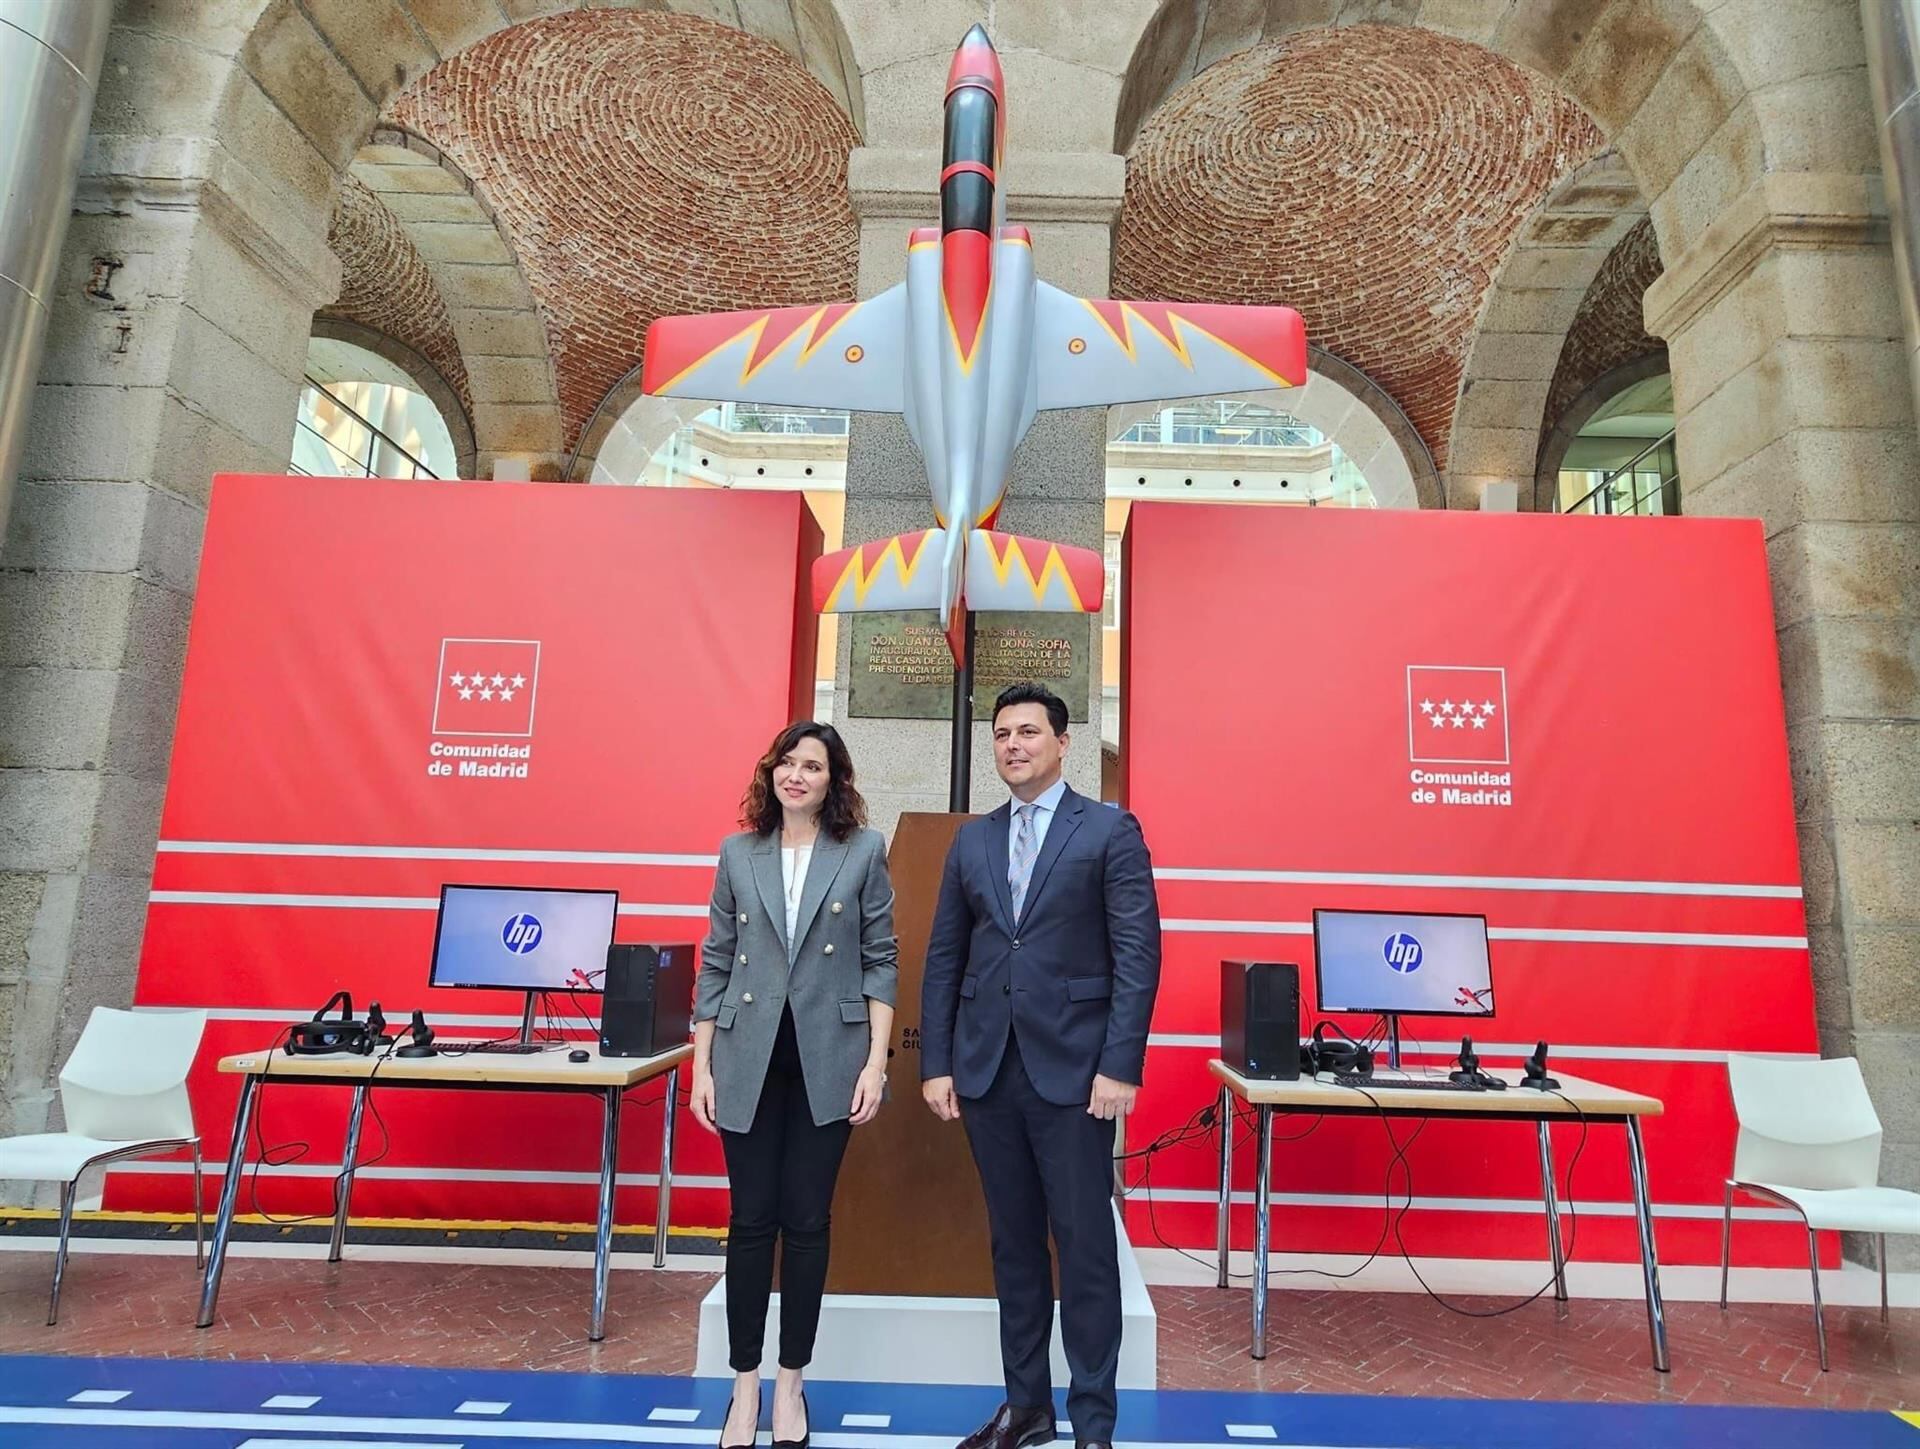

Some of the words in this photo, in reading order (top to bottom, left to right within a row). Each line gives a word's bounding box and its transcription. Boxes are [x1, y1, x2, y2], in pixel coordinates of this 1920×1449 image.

[871, 635, 898, 646] DON
[898, 637, 932, 647] JUAN
[870, 646, 940, 656] INAUGURARON
[1040, 650, 1053, 659] DE
[1057, 650, 1071, 659] LA
[868, 665, 930, 673] PRESIDENCIA
[869, 655, 893, 664] REAL
[895, 656, 922, 665] CASA
[924, 657, 937, 665] DE
[1017, 659, 1041, 668] SEDE
[1042, 660, 1056, 668] DE
[1057, 660, 1071, 668] LA
[903, 674, 914, 683] EL
[430, 741, 531, 759] Comunidad
[428, 760, 452, 776] de
[458, 761, 529, 778] Madrid
[1410, 769, 1511, 786] Comunidad
[1411, 788, 1436, 803] de
[1442, 789, 1512, 805] Madrid
[505, 913, 541, 955] hp
[1388, 932, 1420, 974] hp
